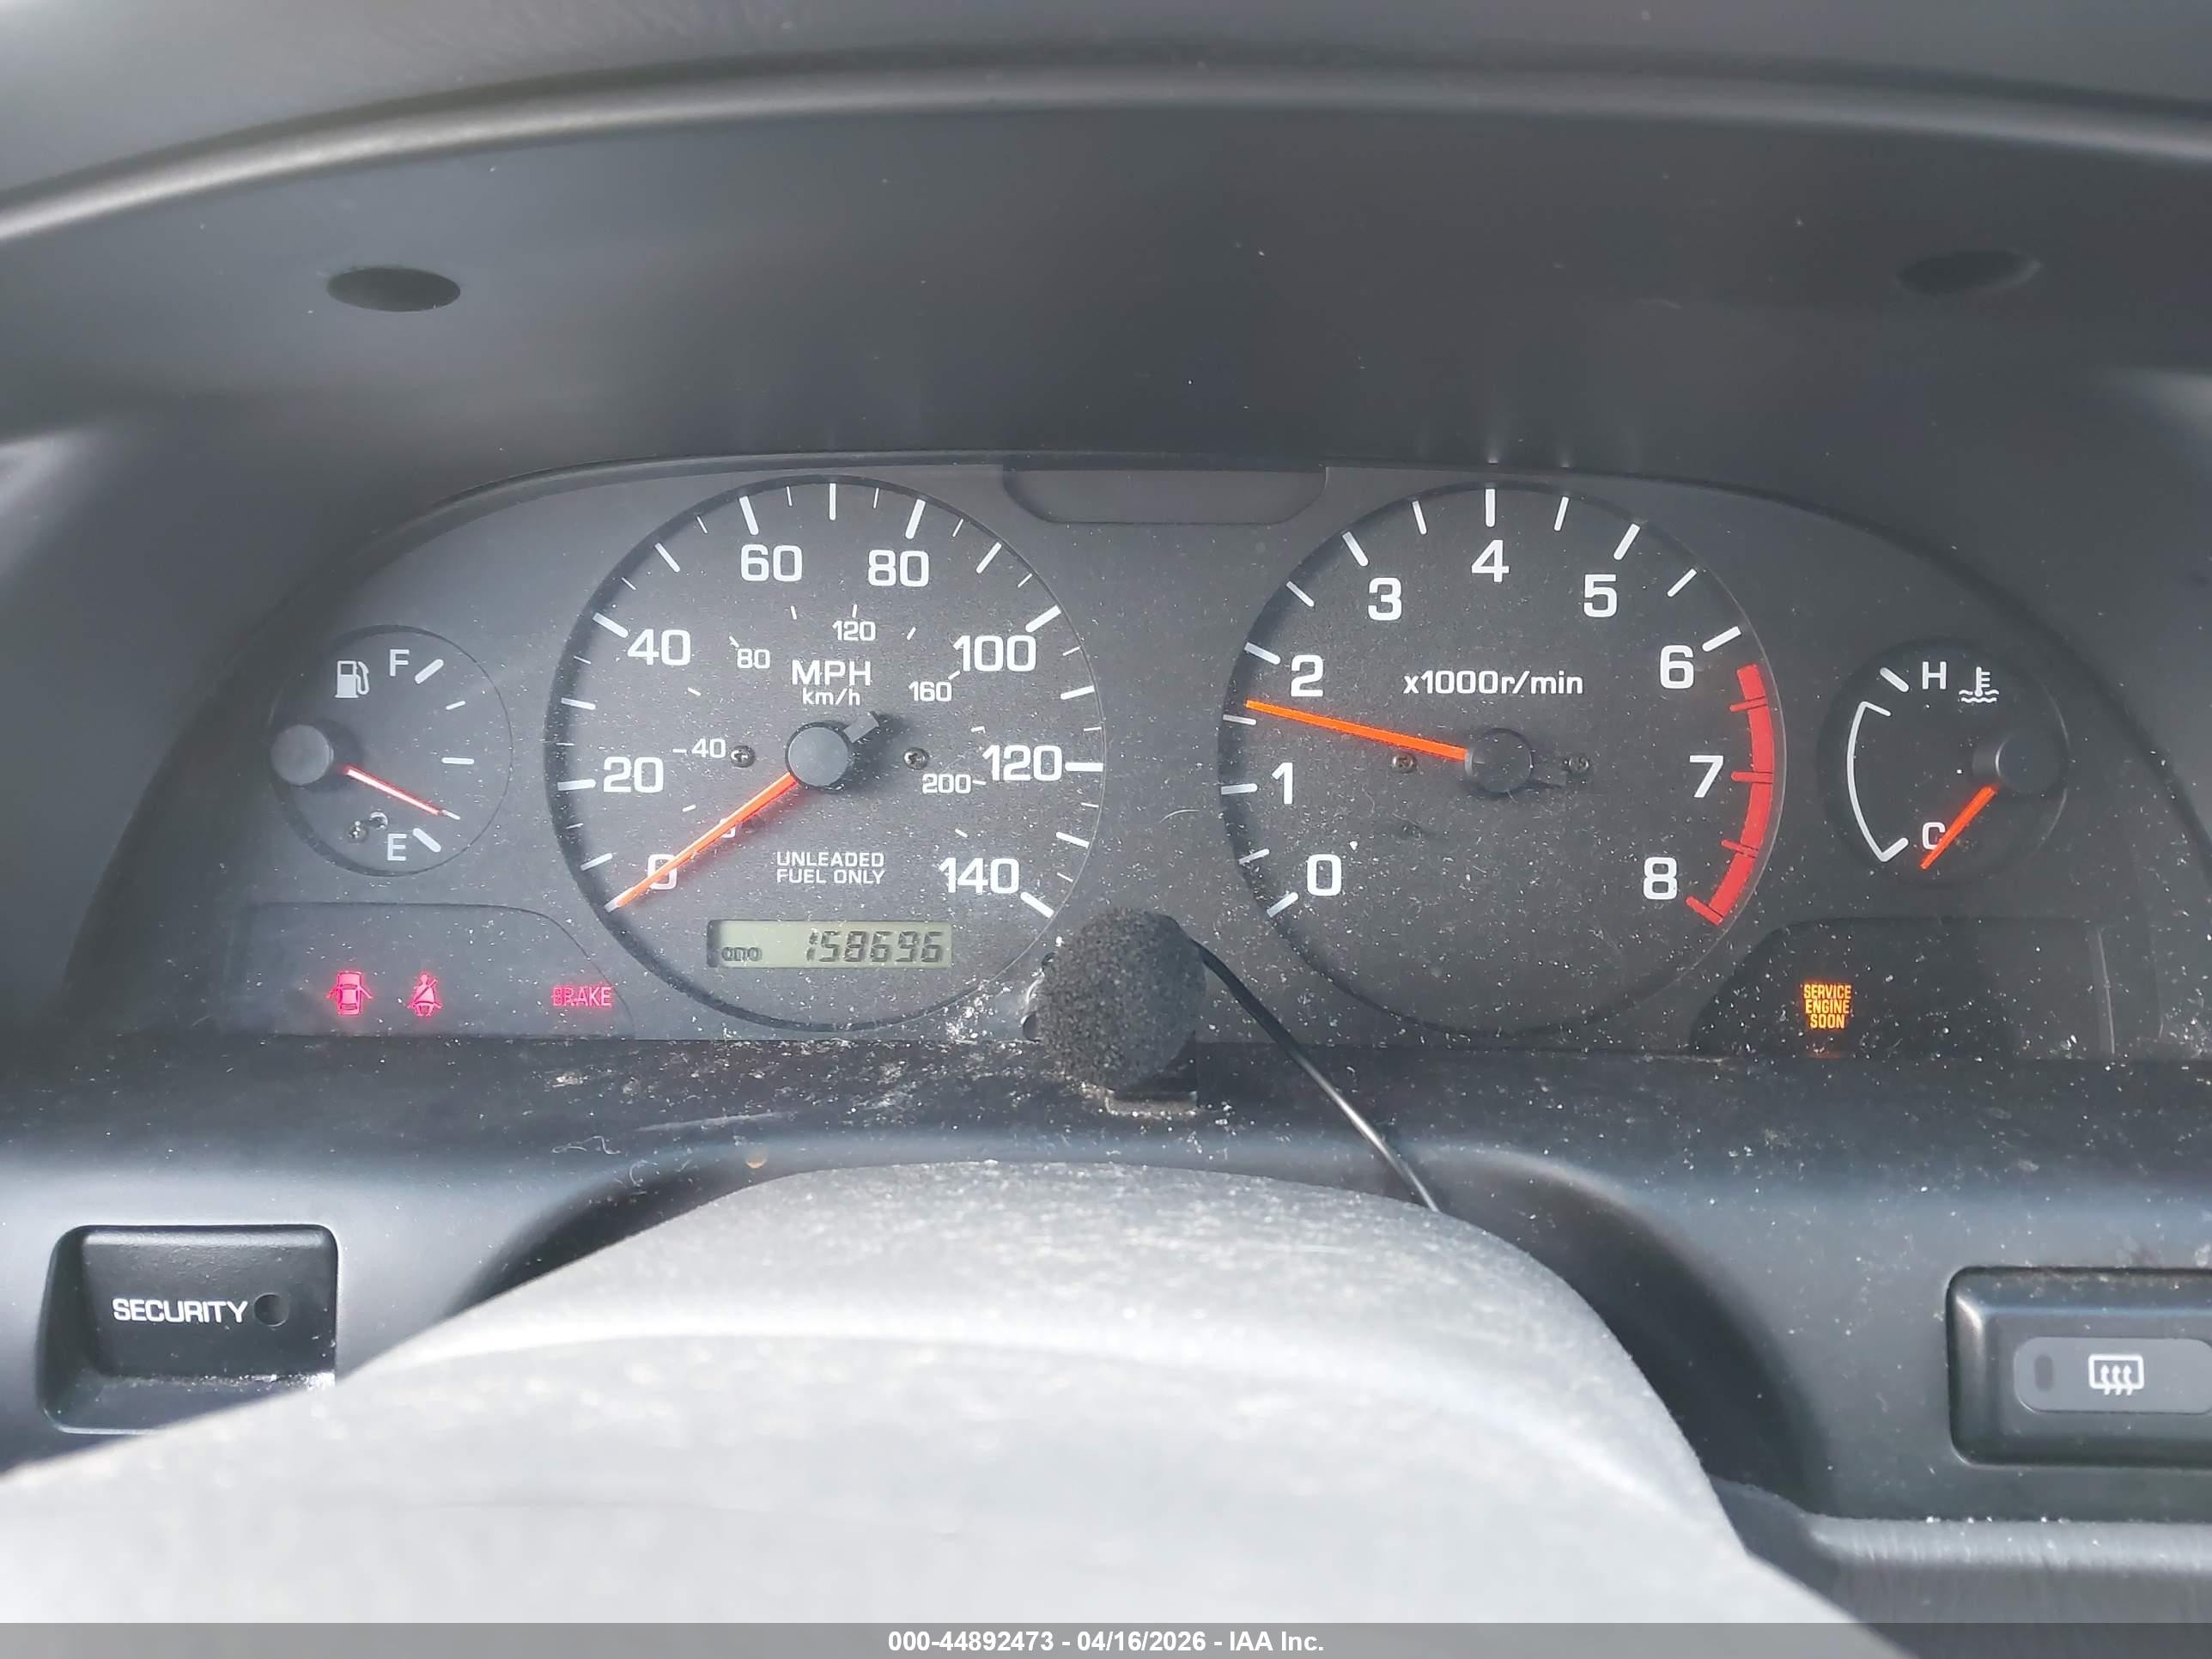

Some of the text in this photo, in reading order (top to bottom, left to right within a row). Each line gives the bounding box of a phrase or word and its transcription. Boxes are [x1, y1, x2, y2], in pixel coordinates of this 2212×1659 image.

[741, 544, 803, 582] 60
[867, 550, 930, 587] 80
[1471, 539, 1510, 582] 4
[1368, 577, 1402, 621] 3
[1583, 574, 1618, 617] 5
[832, 621, 876, 642] 120
[627, 629, 691, 666] 40
[737, 648, 771, 670] 80
[953, 635, 1037, 672] 100
[389, 649, 410, 677] F
[791, 660, 872, 686] MPH
[1291, 654, 1323, 697] 2
[1659, 645, 1694, 689] 6
[1922, 661, 1948, 690] H
[802, 687, 860, 707] km/h
[908, 681, 953, 702] 160
[1403, 670, 1583, 695] x1000r/min
[691, 738, 726, 759] 40
[981, 744, 1063, 782] 120
[603, 757, 665, 793] 20
[922, 774, 971, 795] 200
[1271, 763, 1292, 805] 1
[1689, 755, 1724, 799] 7
[386, 833, 408, 861] E
[776, 851, 885, 868] UNLEADED
[776, 868, 886, 884] FUEL ONLY
[939, 857, 1020, 894] 140
[1307, 854, 1342, 896] 0
[1644, 857, 1678, 900] 8
[805, 930, 943, 963] 158696
[552, 986, 612, 1007] BRAKE
[1803, 984, 1852, 1000] SERVICE
[1805, 999, 1850, 1014] ENGINE
[1809, 1013, 1845, 1029] SOON
[112, 1298, 248, 1323] SECURITY
